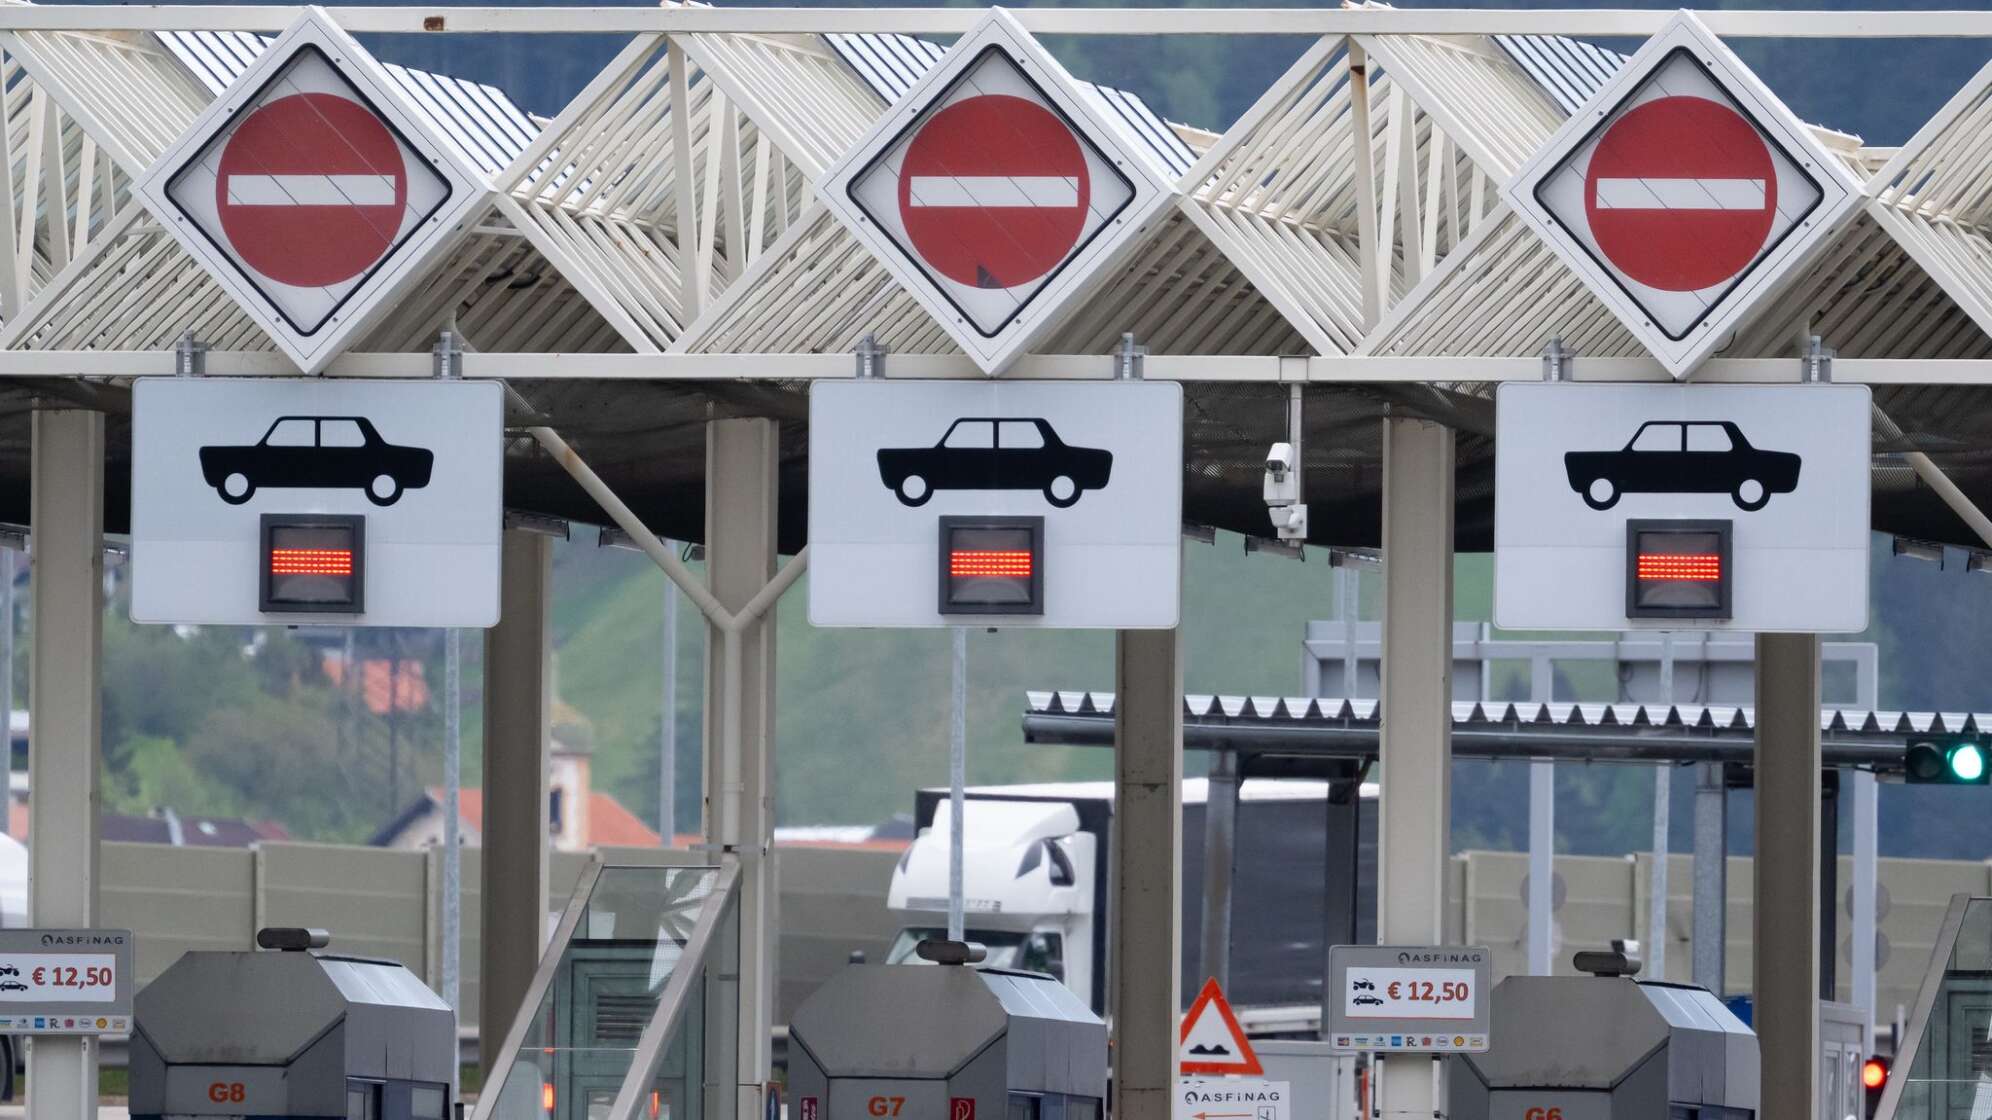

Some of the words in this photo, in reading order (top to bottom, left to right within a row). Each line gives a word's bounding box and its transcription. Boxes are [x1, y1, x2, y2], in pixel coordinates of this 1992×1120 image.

[32, 966, 46, 986] €
[52, 966, 113, 990] 12,50
[1387, 981, 1402, 1000] €
[1408, 981, 1469, 1004] 12,50
[208, 1082, 246, 1103] G8
[868, 1096, 906, 1117] G7
